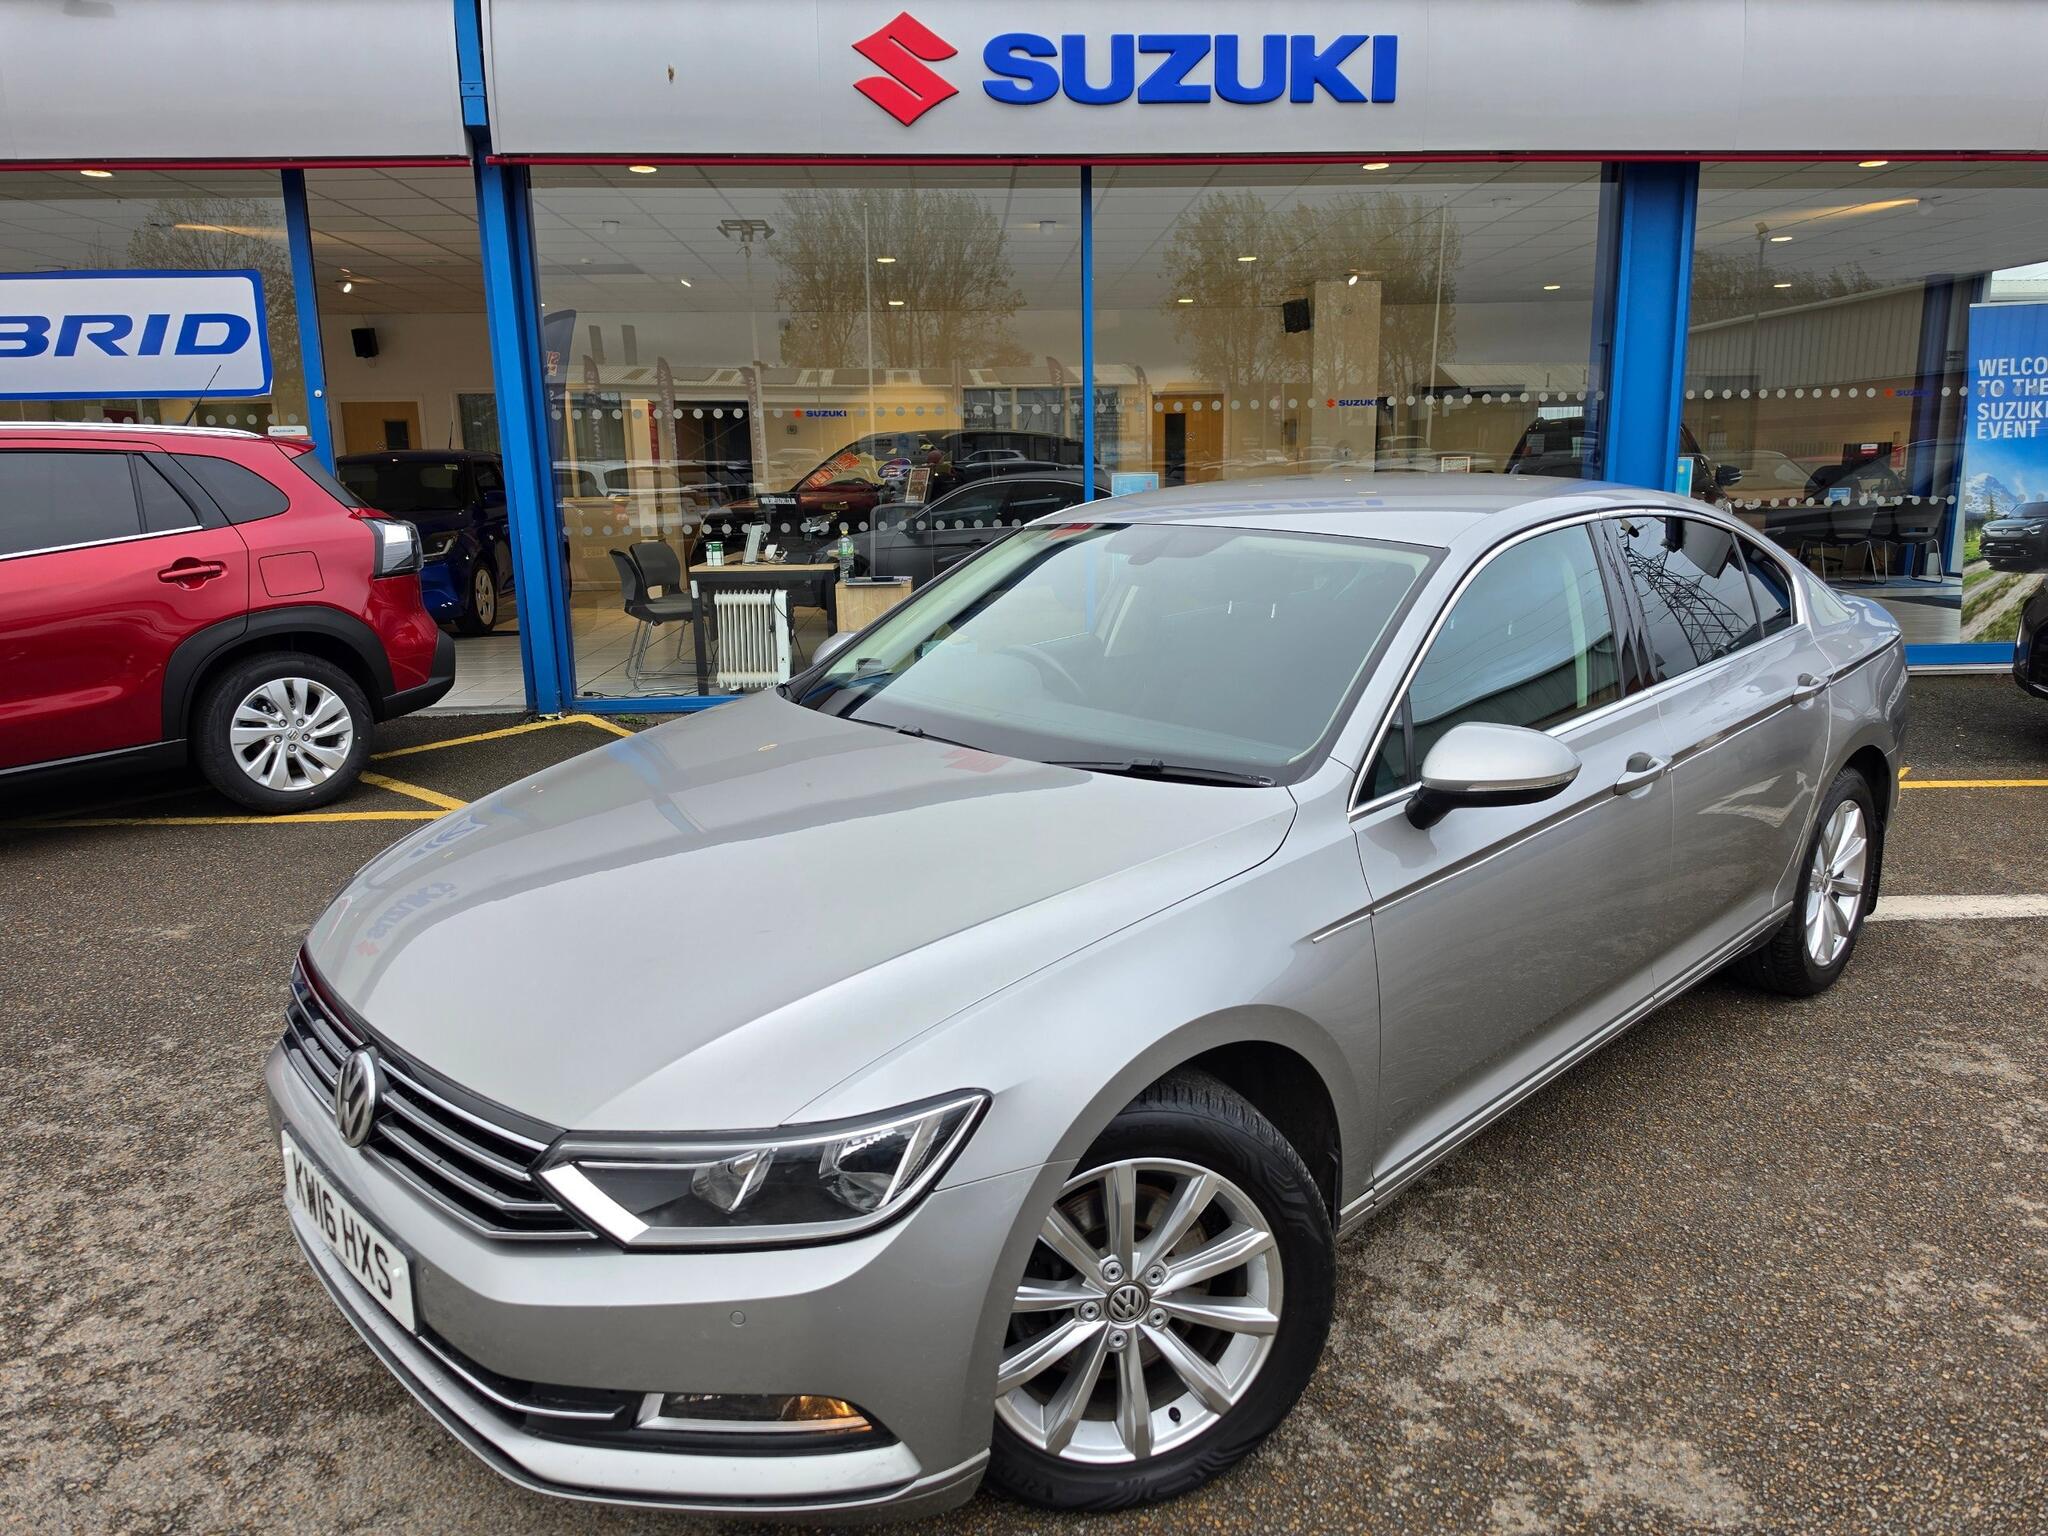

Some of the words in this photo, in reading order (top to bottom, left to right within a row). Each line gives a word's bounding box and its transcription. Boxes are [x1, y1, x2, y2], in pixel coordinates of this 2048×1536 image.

[982, 32, 1398, 105] SUZUKI
[0, 313, 251, 357] BRID
[1979, 357, 2048, 376] WELCO
[1977, 379, 2004, 397] TO
[2013, 378, 2048, 396] THE
[1338, 399, 1380, 407] SUZUKI
[1977, 420, 2040, 439] EVENT
[293, 1152, 338, 1243] KW16
[341, 1207, 392, 1300] HXS
